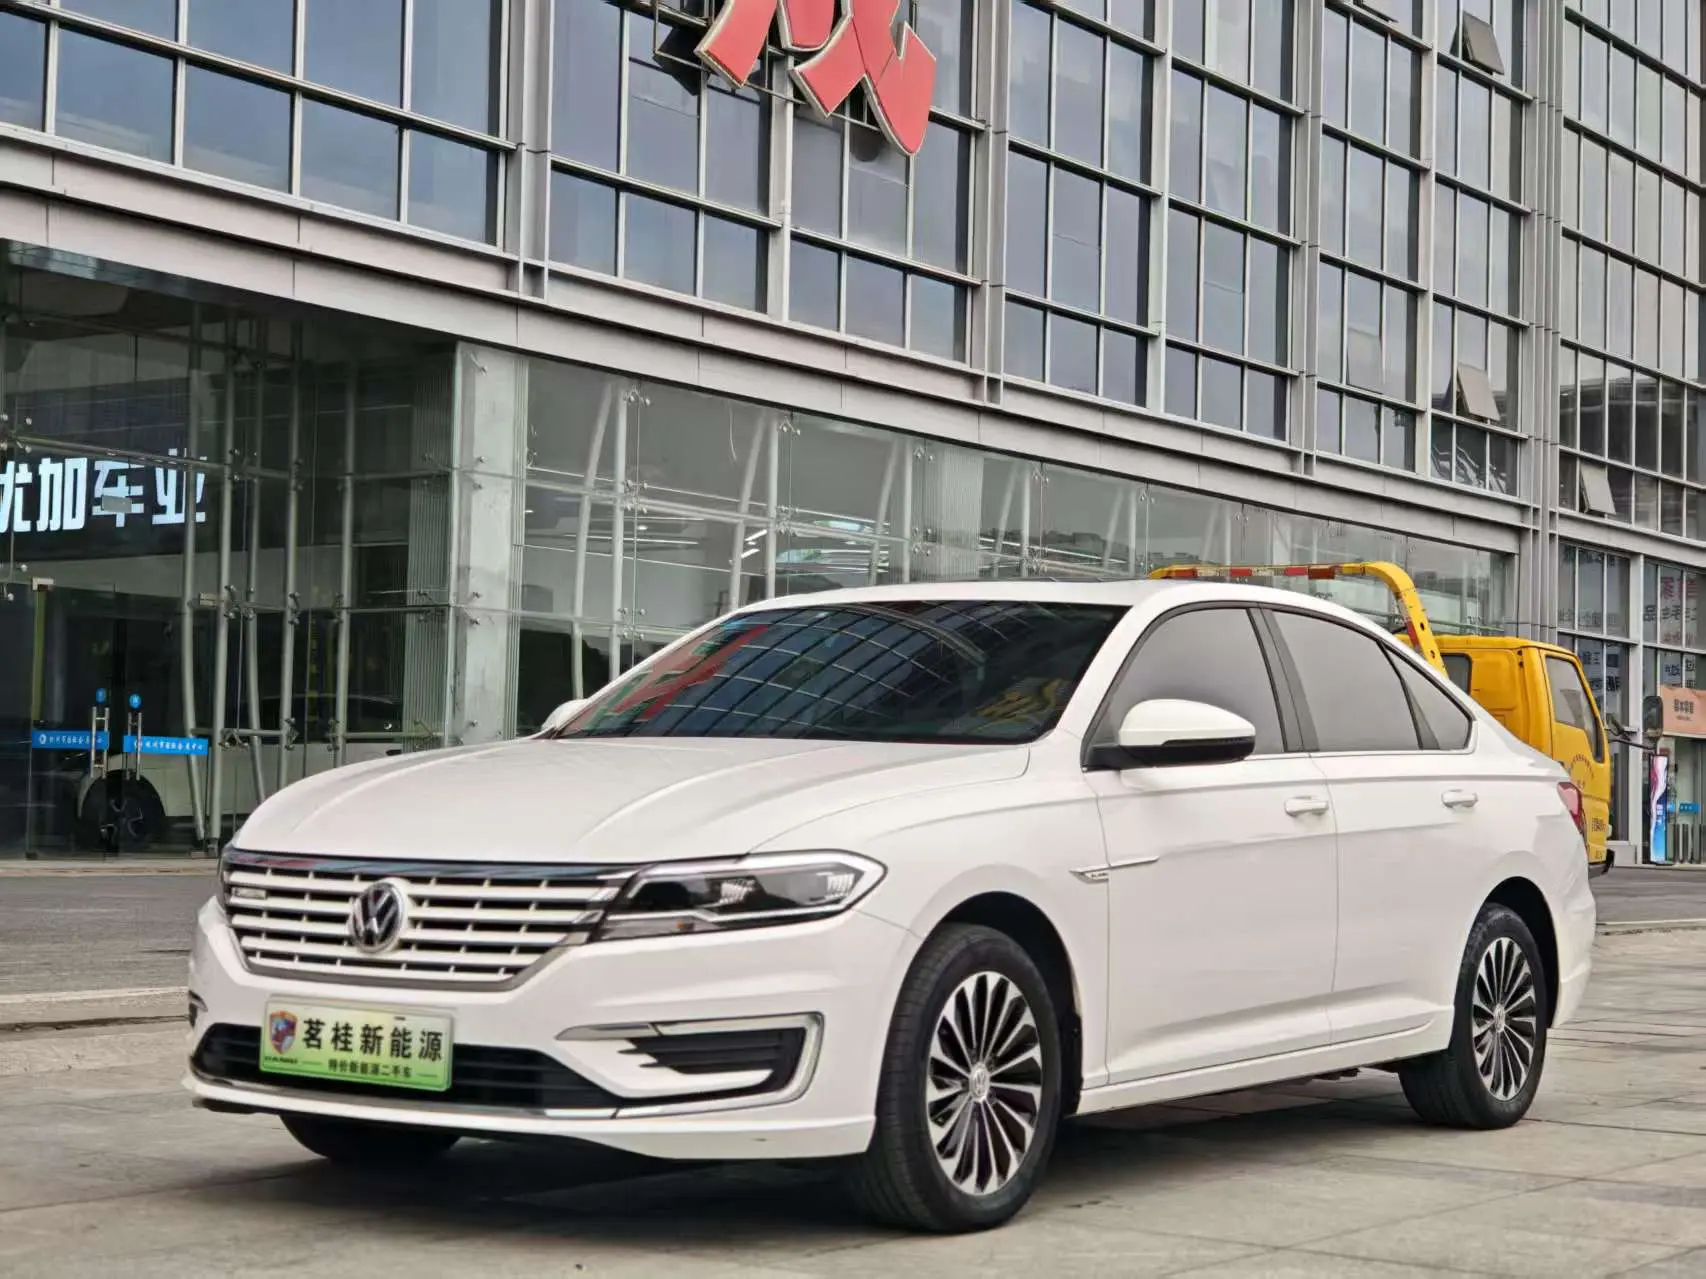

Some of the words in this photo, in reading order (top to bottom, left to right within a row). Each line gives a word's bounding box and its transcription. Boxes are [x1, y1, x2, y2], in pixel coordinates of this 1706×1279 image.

[303, 1018, 443, 1062] 茗桂新能源
